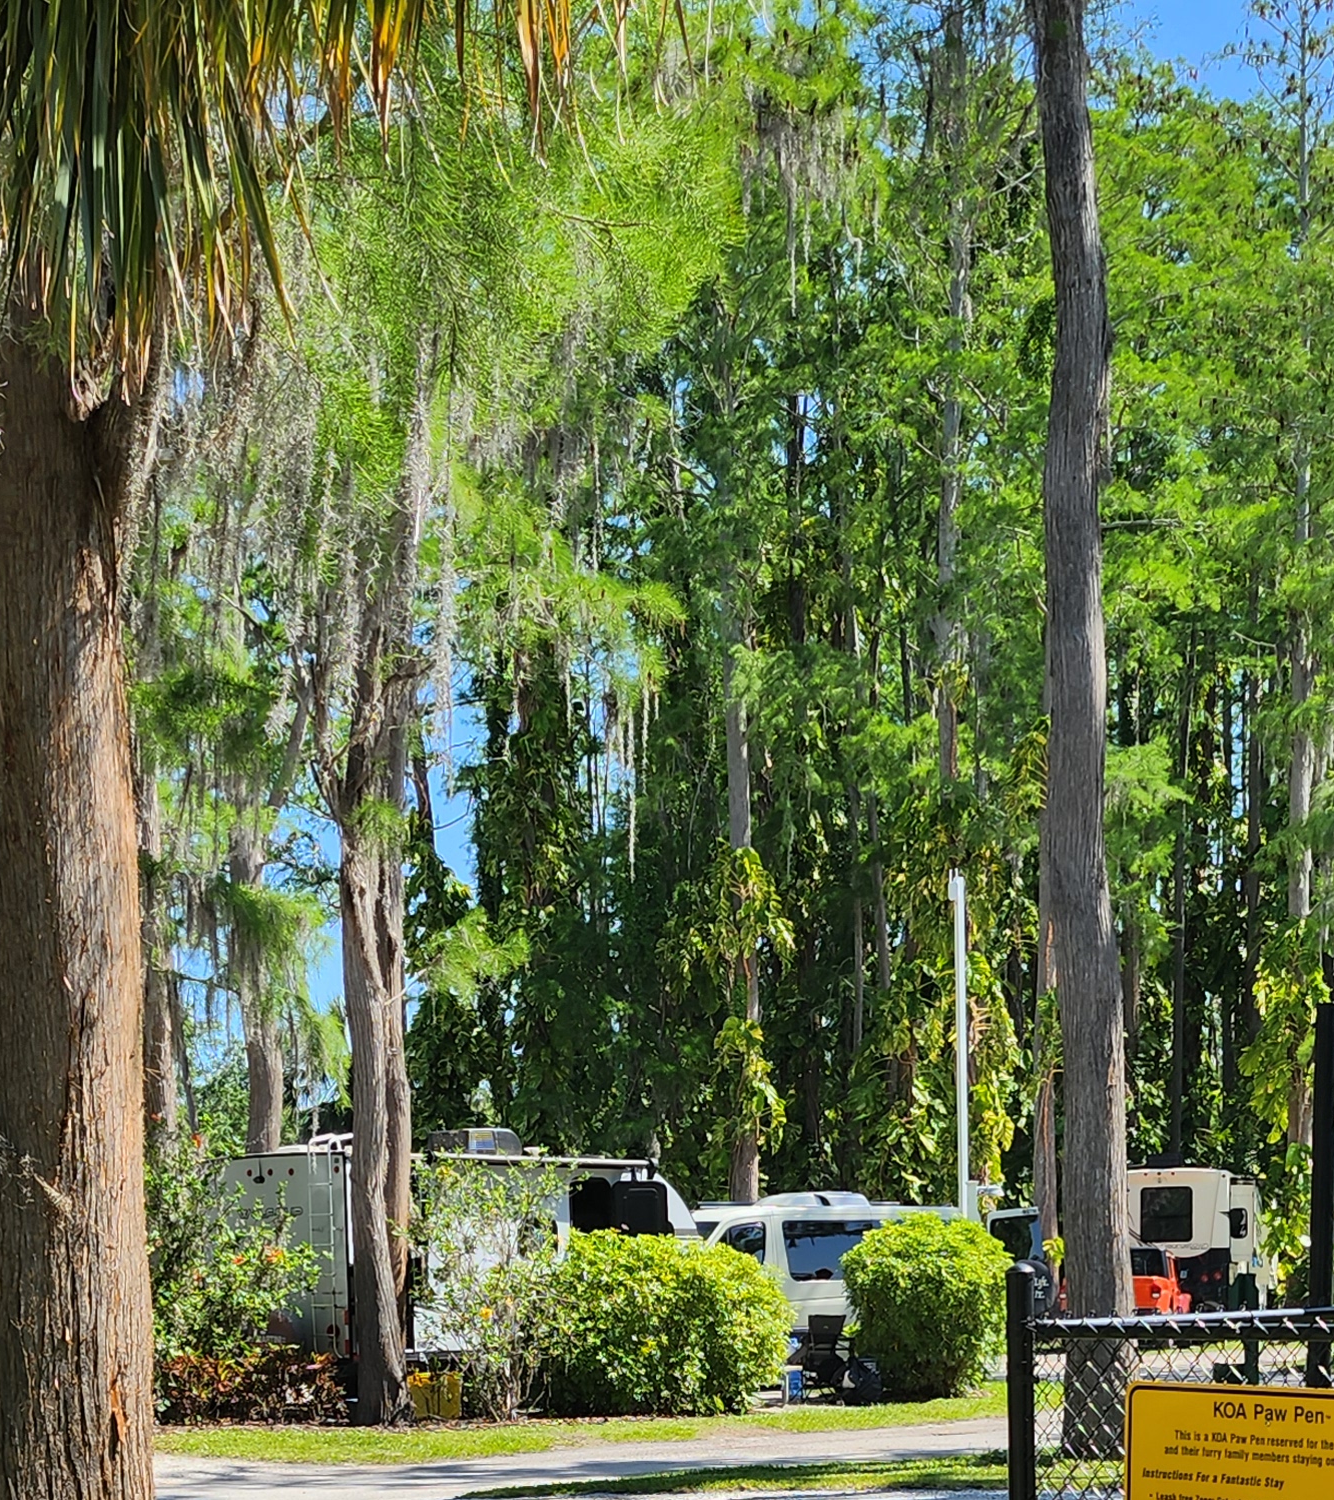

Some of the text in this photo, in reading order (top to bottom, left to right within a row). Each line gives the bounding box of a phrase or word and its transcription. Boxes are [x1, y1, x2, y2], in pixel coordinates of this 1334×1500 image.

[1213, 1401, 1247, 1420] KOA
[1254, 1403, 1287, 1422] Paw
[1175, 1429, 1191, 1441] This
[1194, 1431, 1201, 1442] is
[1204, 1433, 1209, 1442] a
[1211, 1432, 1227, 1443] KOA
[1230, 1433, 1247, 1445] Paw
[1250, 1434, 1265, 1446] Pen
[1267, 1437, 1304, 1449] reserved
[1307, 1438, 1318, 1449] for
[1321, 1439, 1334, 1450] the
[1164, 1445, 1179, 1455] and
[1181, 1445, 1199, 1456] their
[1202, 1447, 1222, 1460] furry
[1225, 1448, 1249, 1462] family
[1252, 1451, 1289, 1463] members
[1293, 1454, 1322, 1468] staying
[1142, 1468, 1284, 1491] Instructions For a Fantastic Stay
